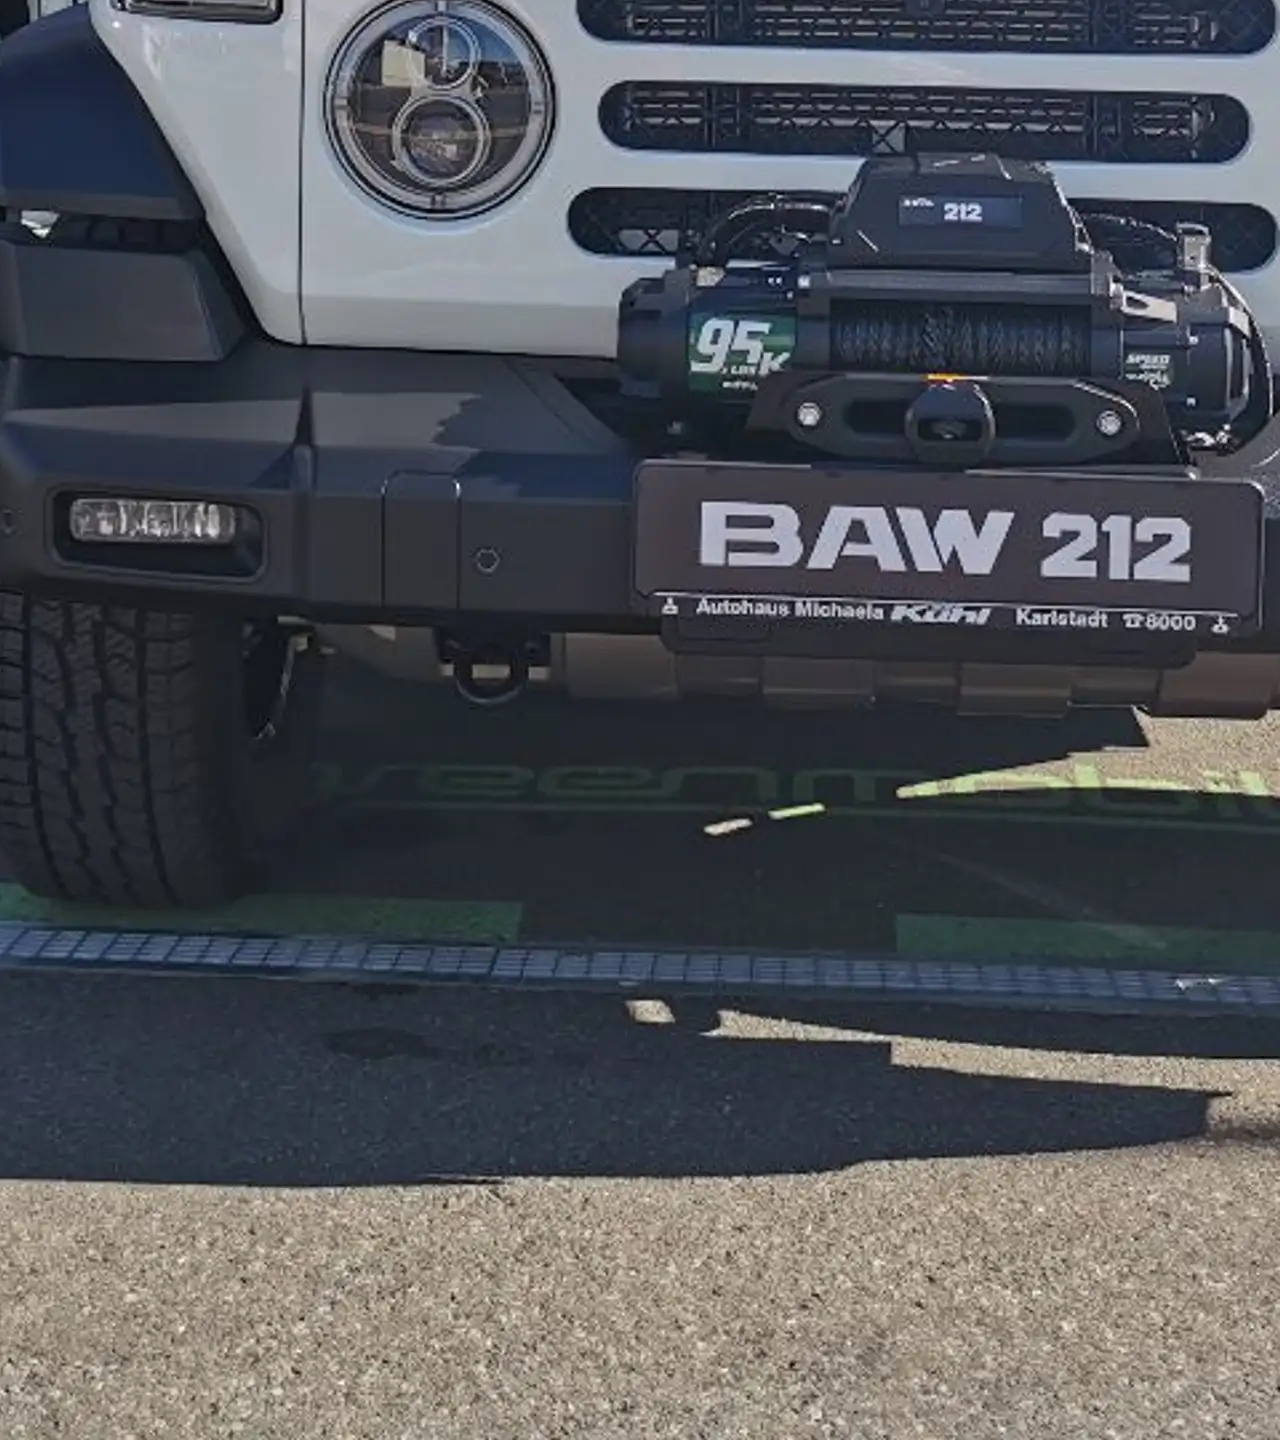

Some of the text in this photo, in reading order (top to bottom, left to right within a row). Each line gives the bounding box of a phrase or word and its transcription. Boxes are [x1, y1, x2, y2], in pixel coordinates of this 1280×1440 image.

[943, 201, 983, 222] 212
[700, 501, 1192, 582] BAW 212
[695, 596, 789, 617] Autohaus
[794, 599, 885, 621] Michaela
[1015, 607, 1109, 629] Karlstadt
[1144, 613, 1197, 632] 8000
